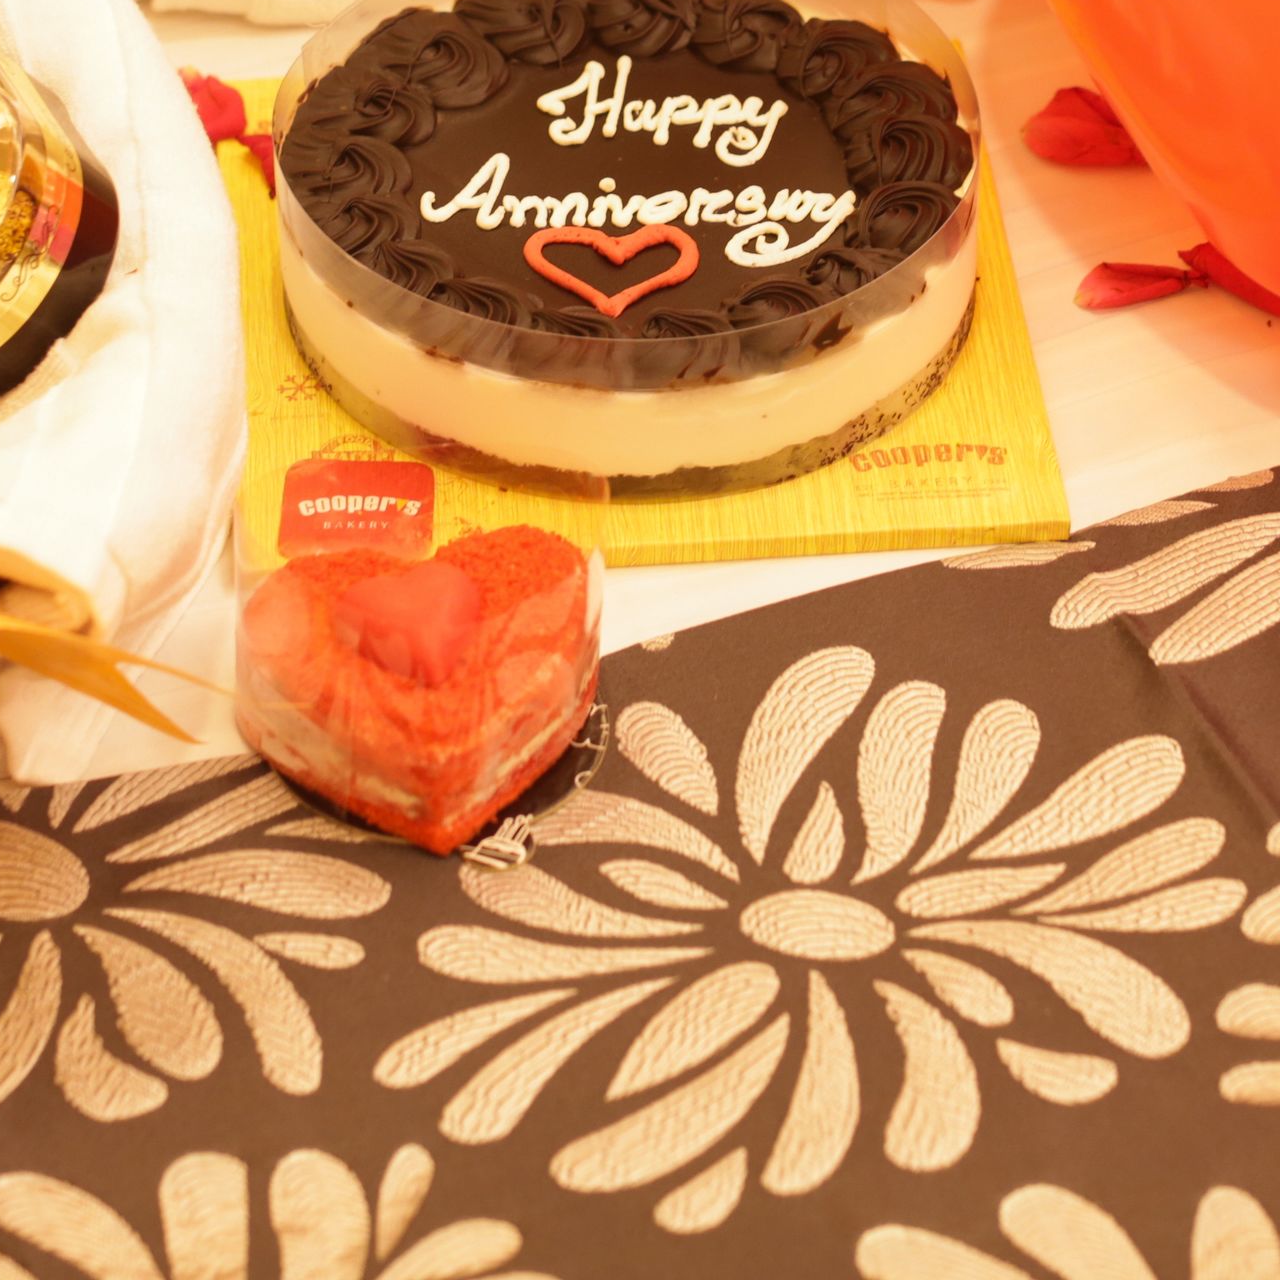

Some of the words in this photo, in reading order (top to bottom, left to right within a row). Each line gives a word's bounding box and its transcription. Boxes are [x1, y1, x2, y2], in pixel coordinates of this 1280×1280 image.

[536, 54, 789, 168] Happy
[420, 151, 857, 268] Anniversary
[322, 520, 389, 530] BAKERY
